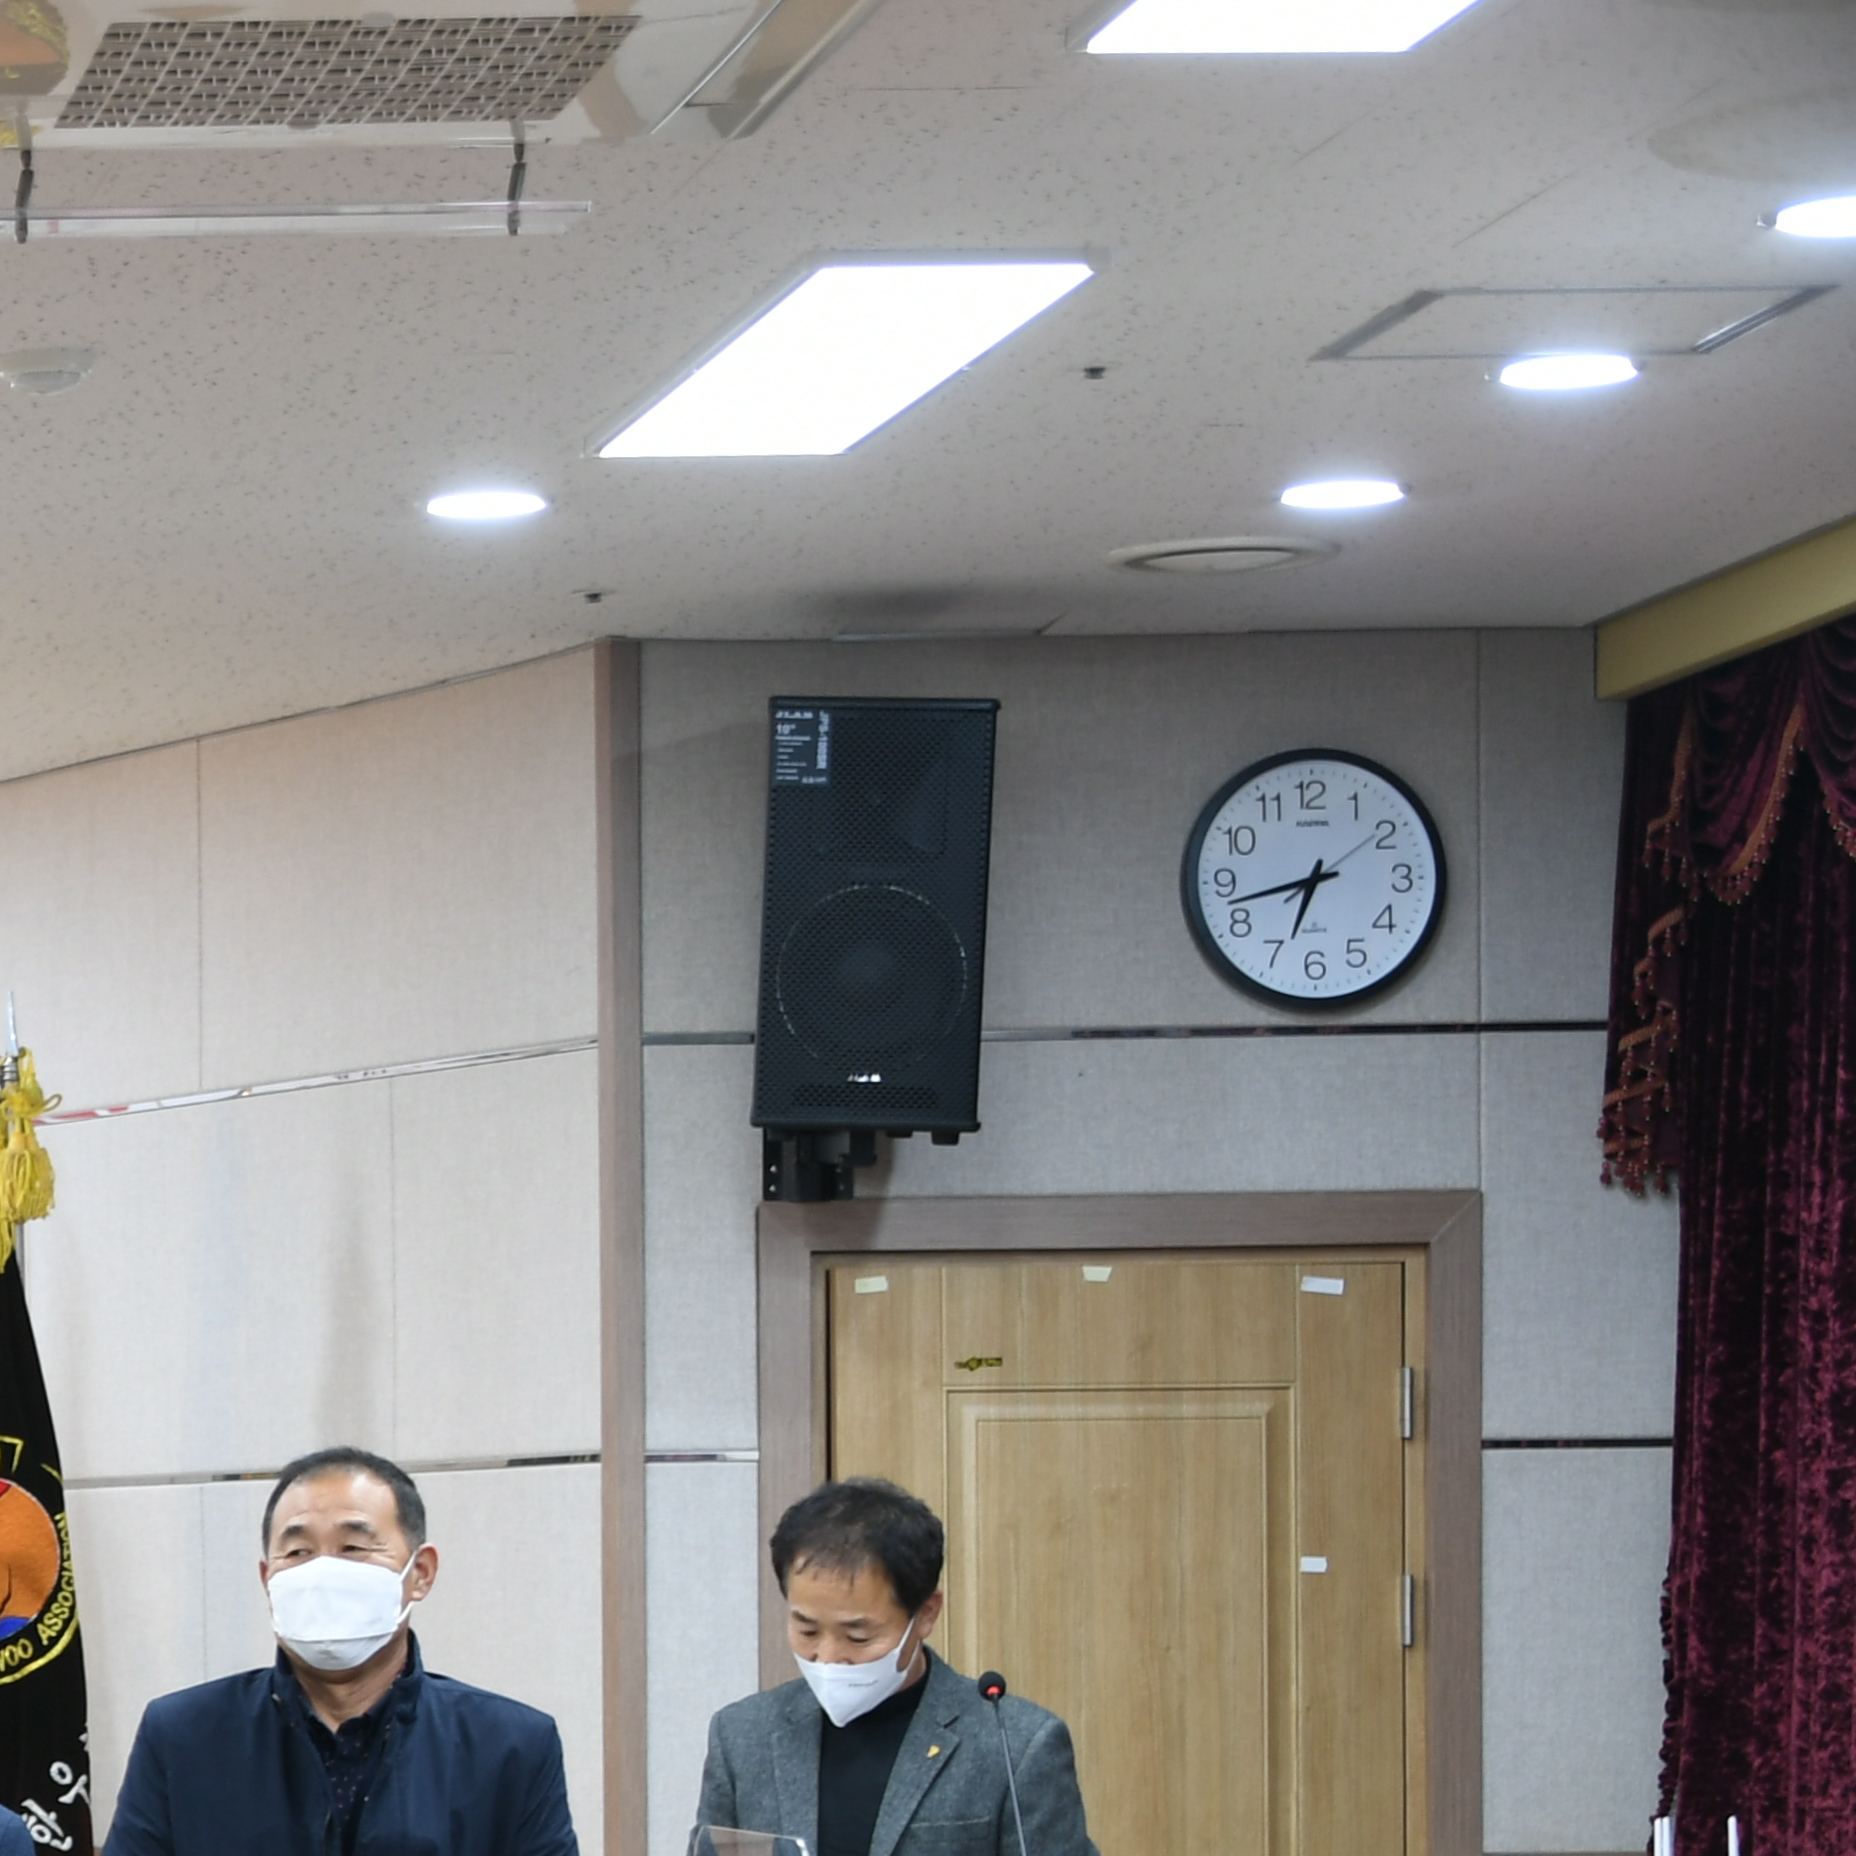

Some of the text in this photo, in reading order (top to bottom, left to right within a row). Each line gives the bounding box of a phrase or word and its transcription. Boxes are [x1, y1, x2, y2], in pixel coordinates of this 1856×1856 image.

[1256, 792, 1281, 822] 11
[1294, 780, 1327, 810] 12
[1348, 791, 1359, 821] 1
[1222, 825, 1256, 856] 10
[1375, 820, 1397, 850] 2
[1213, 868, 1237, 898] 9
[1391, 863, 1414, 893] 3
[1229, 907, 1252, 938] 8
[1371, 903, 1397, 934] 4
[1263, 939, 1285, 969] 7
[1304, 950, 1327, 980] 6
[1345, 938, 1367, 968] 5
[19, 1732, 90, 1852] 한우
